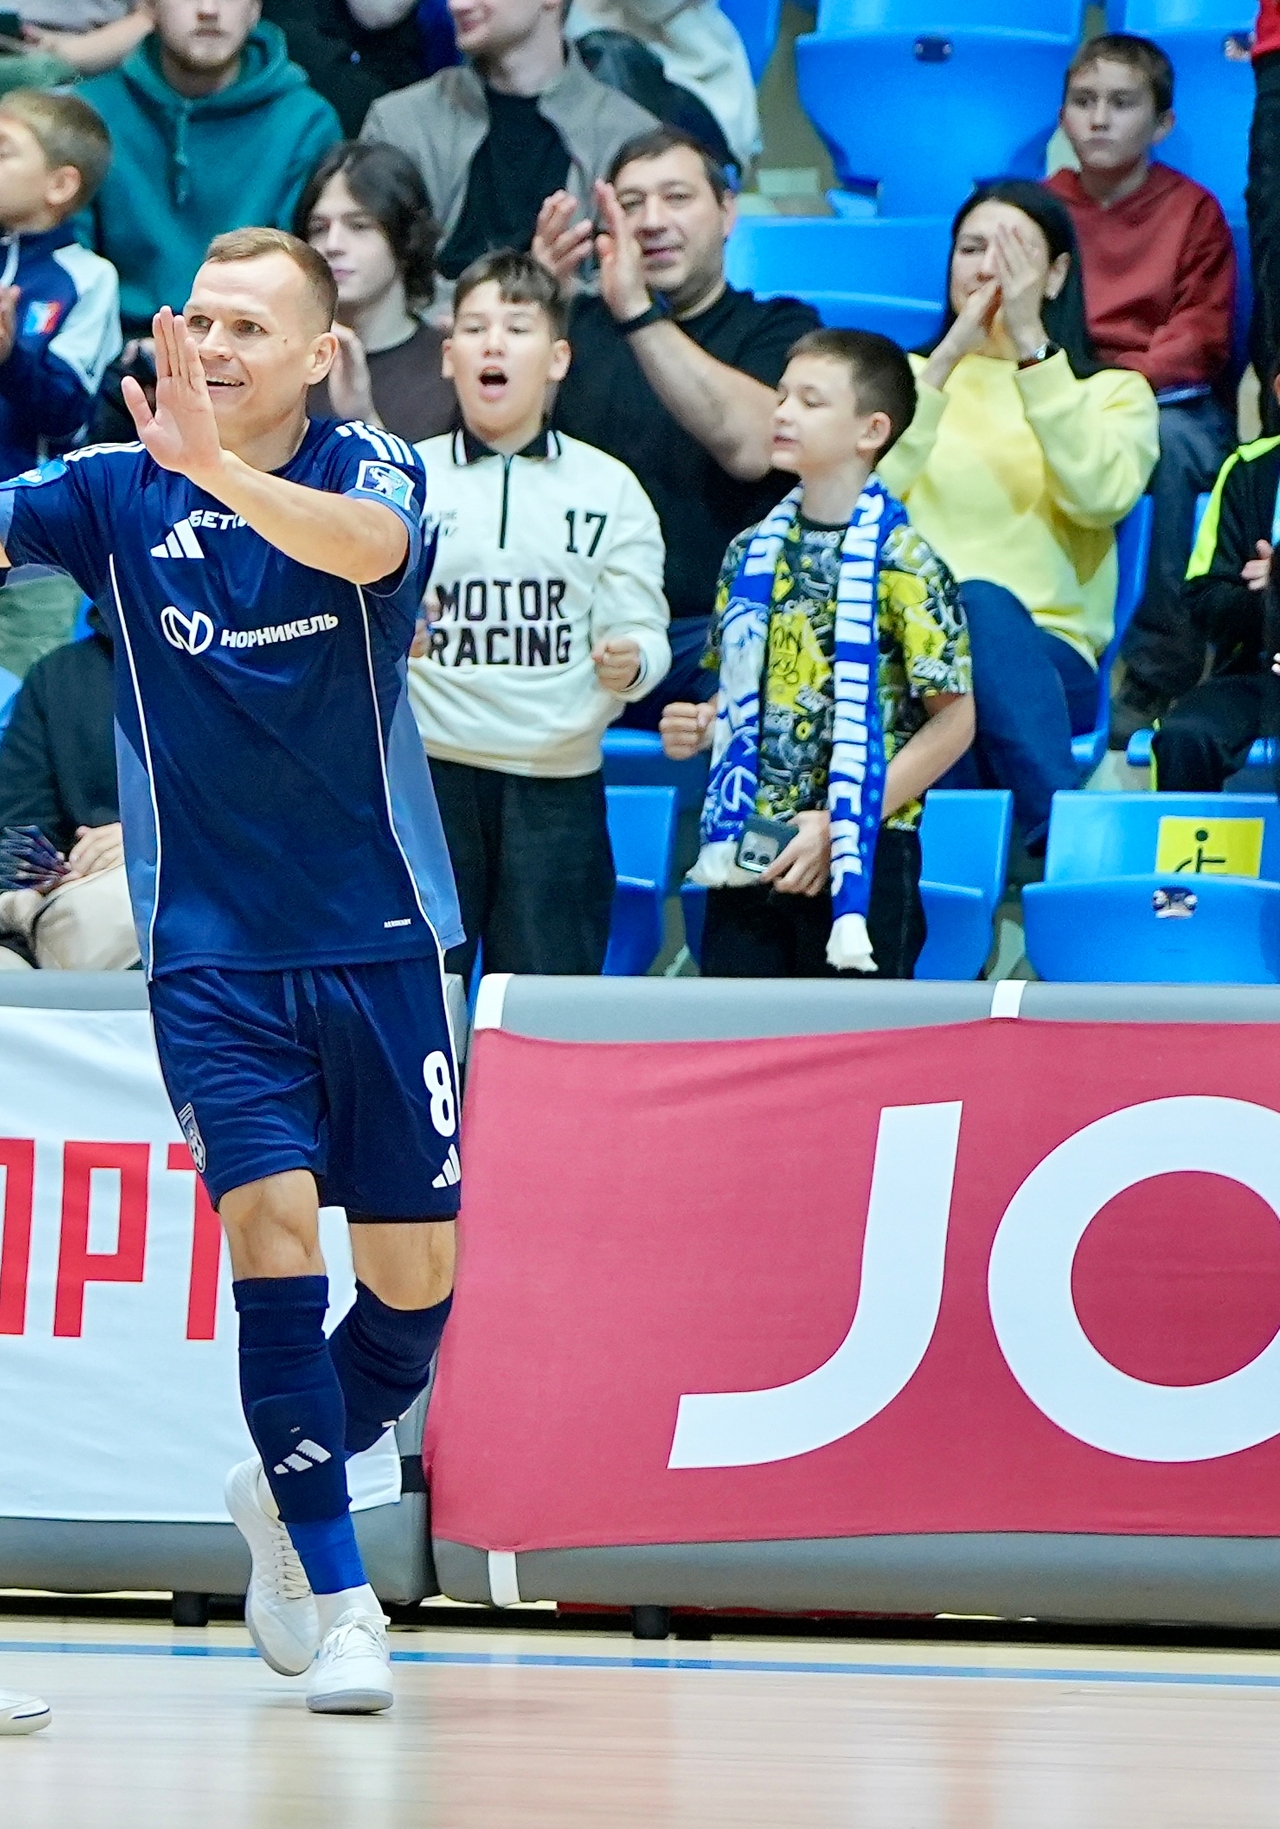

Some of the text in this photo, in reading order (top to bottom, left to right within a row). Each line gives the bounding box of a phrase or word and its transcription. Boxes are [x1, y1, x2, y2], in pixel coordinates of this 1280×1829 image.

[565, 509, 607, 558] 17
[435, 579, 569, 622] MOTOR
[220, 612, 339, 649] НОРНИКЕЛЬ
[428, 623, 572, 667] RACING
[422, 1050, 457, 1138] 8
[667, 1095, 1280, 1470] JO
